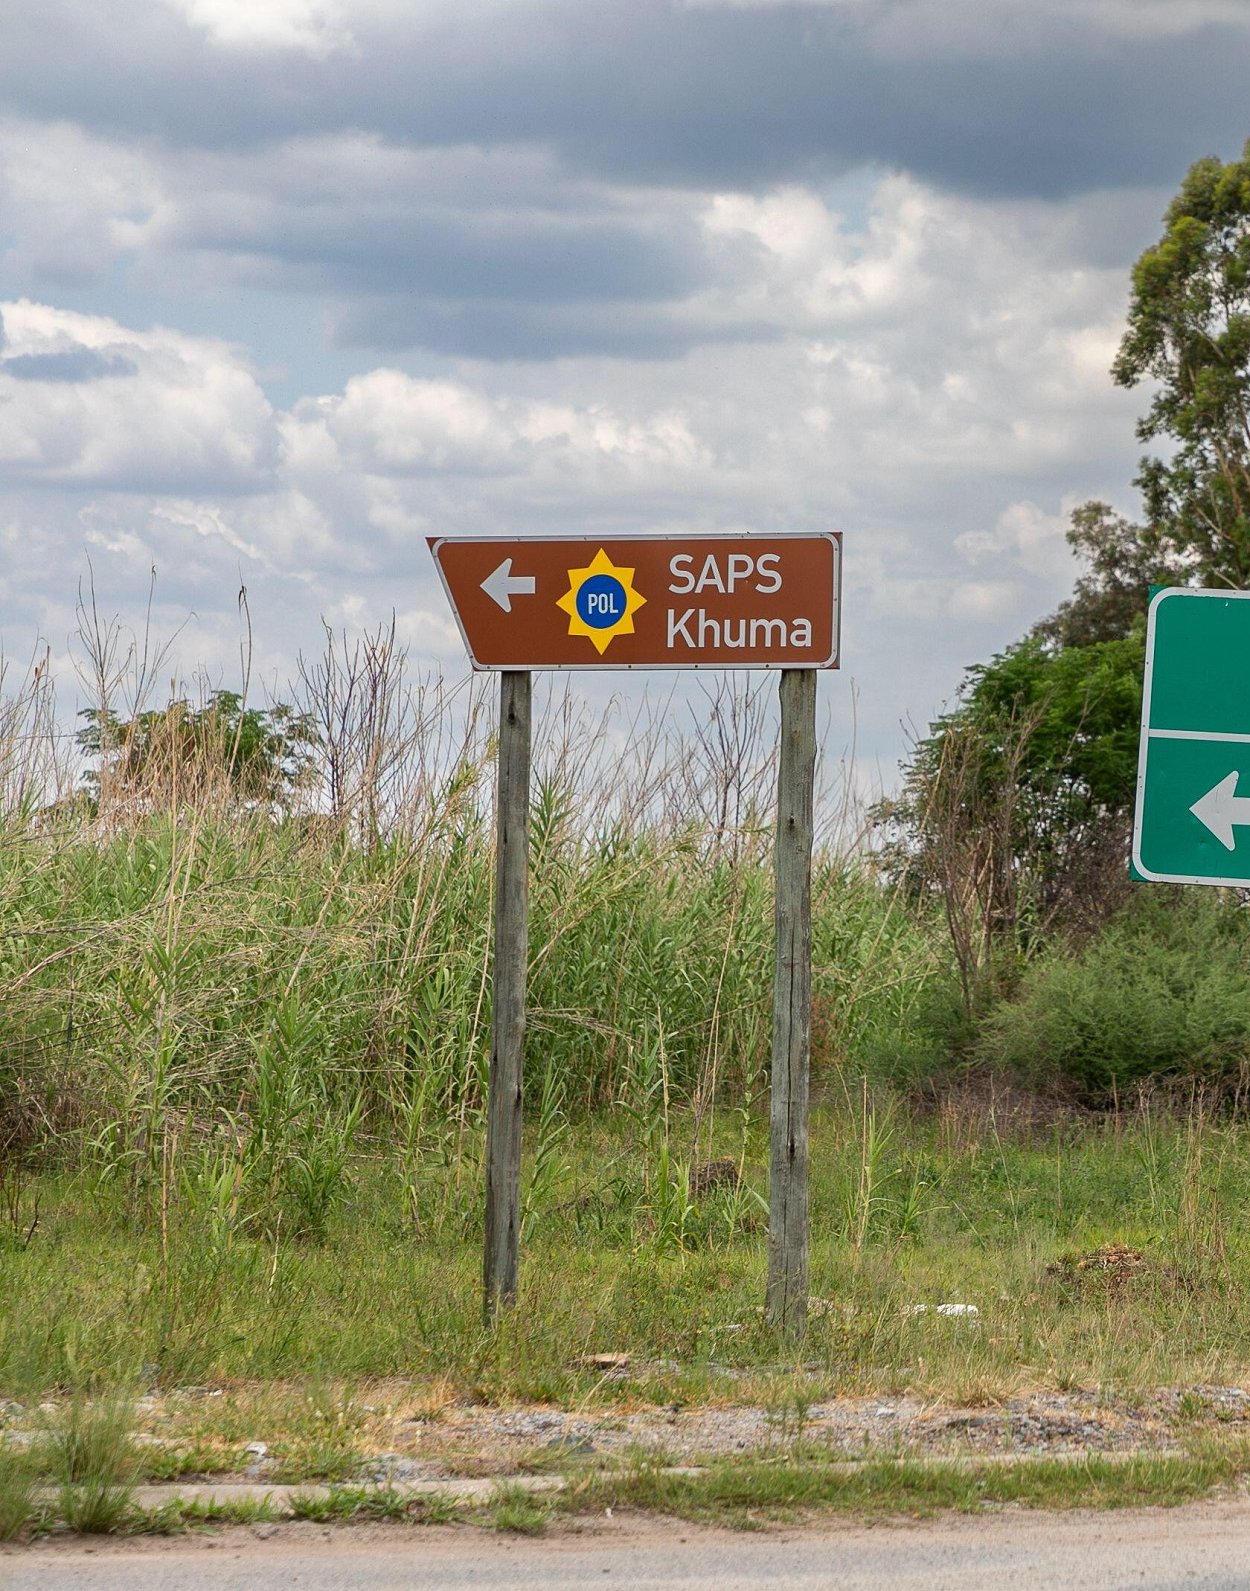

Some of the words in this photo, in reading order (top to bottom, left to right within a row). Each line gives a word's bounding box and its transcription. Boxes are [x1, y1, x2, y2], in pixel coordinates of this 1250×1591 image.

[668, 553, 783, 595] SAPS
[588, 593, 619, 614] POL
[667, 608, 812, 648] Khuma
